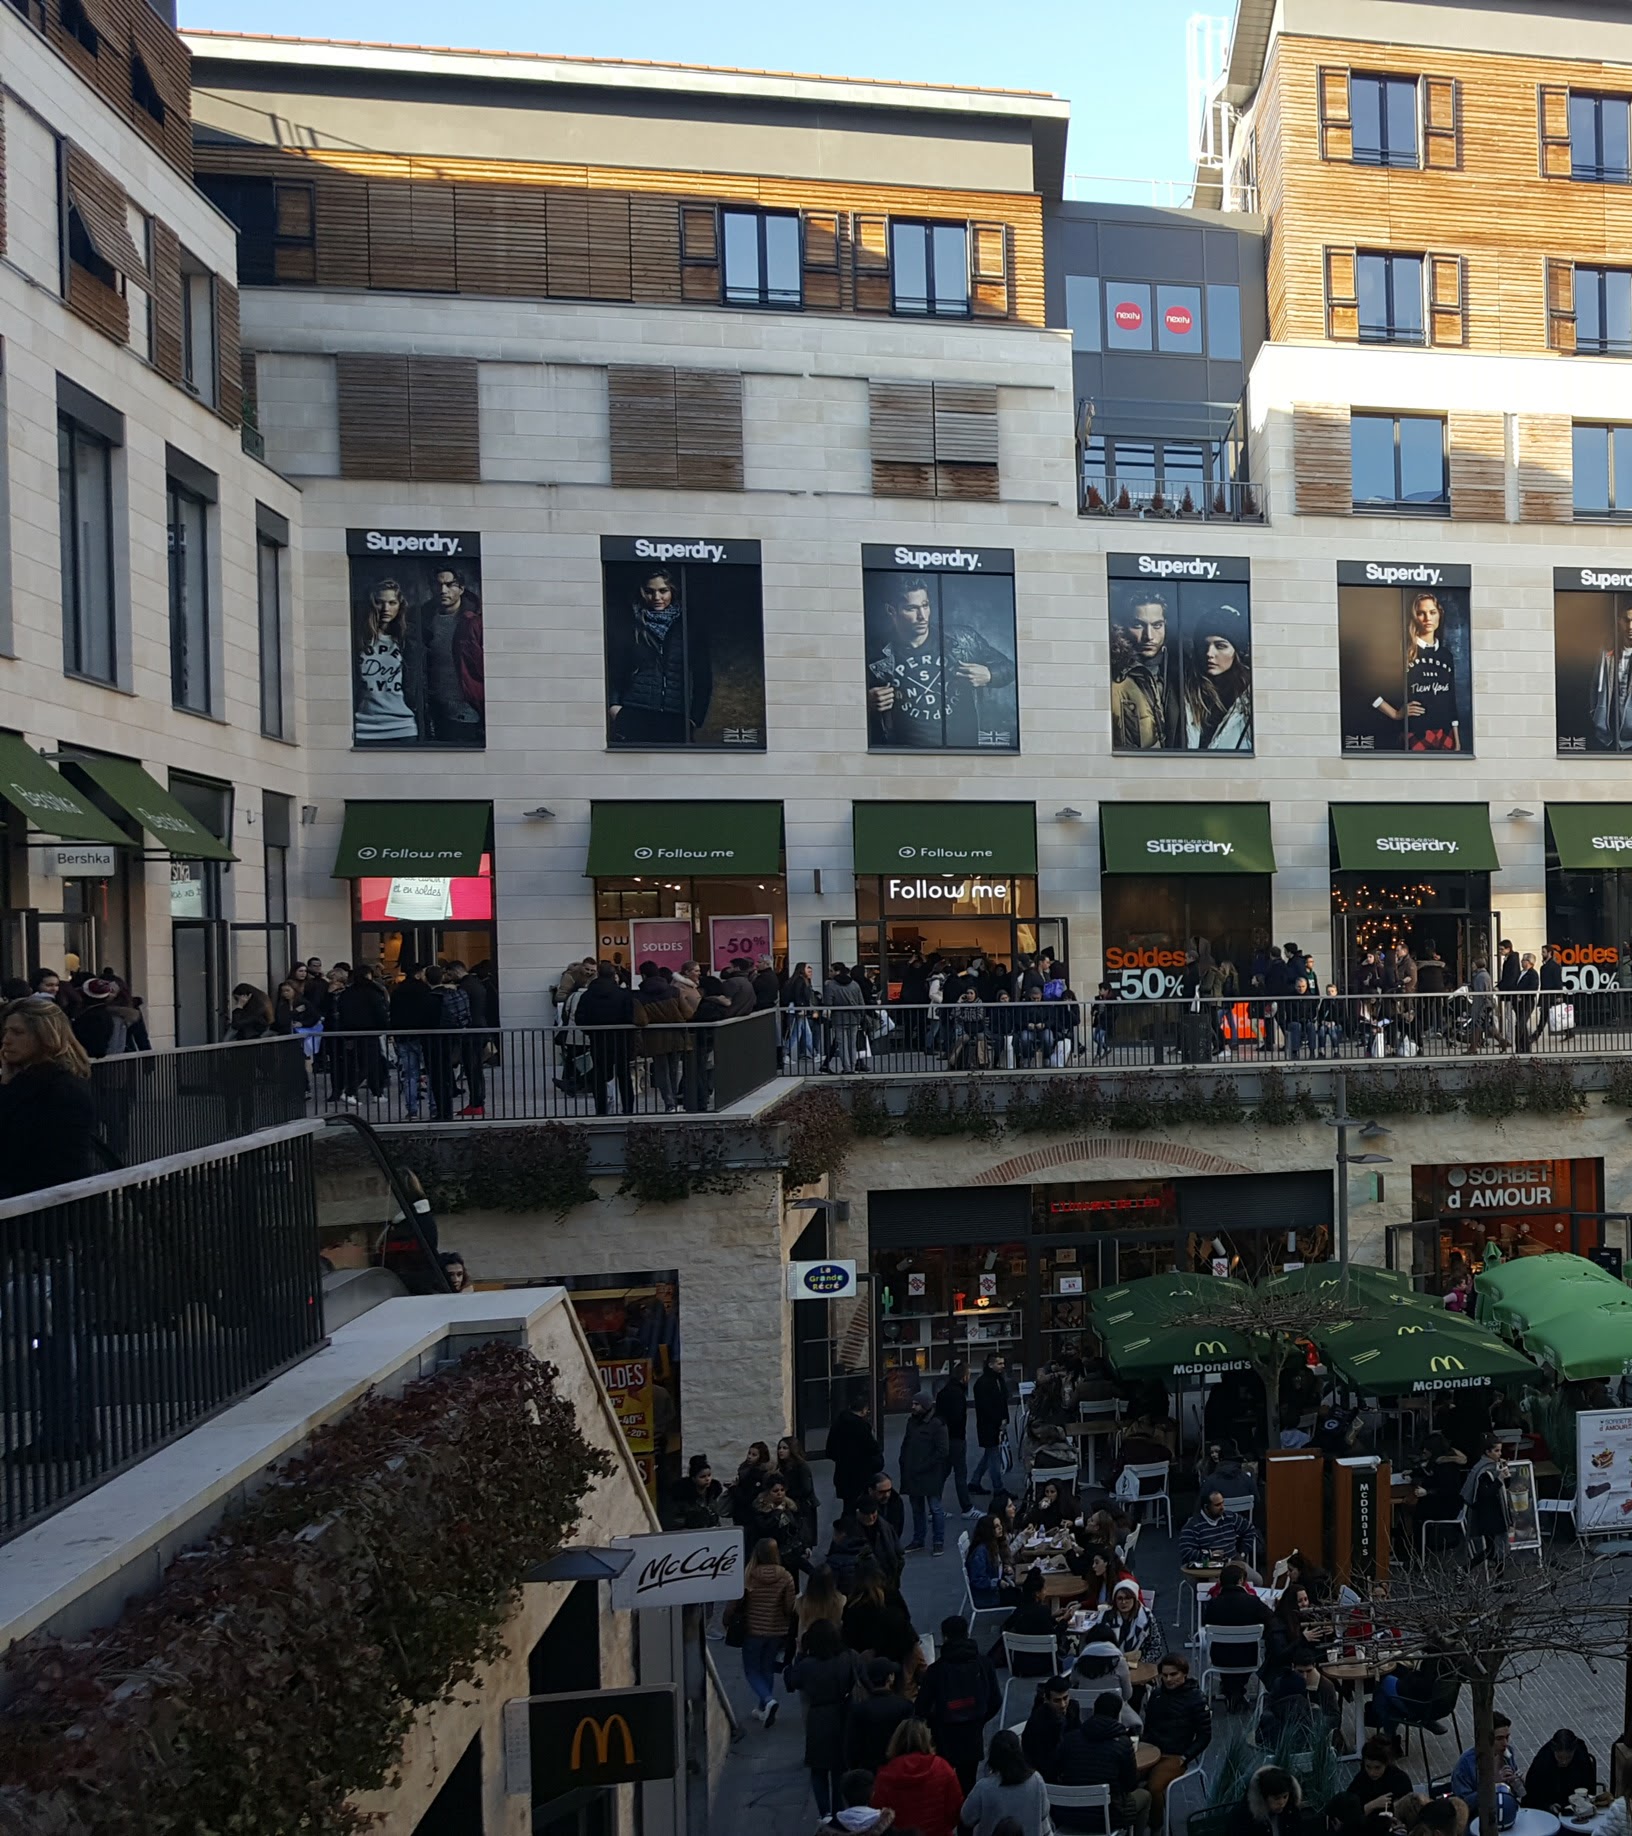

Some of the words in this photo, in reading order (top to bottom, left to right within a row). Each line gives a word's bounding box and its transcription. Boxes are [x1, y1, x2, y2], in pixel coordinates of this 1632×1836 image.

[1116, 311, 1140, 320] nexity
[1166, 315, 1190, 324] nexity
[366, 531, 463, 557] Superdry.
[635, 539, 728, 563] Superdry.
[895, 547, 982, 571] Superdry.
[1138, 556, 1221, 579] Superdry.
[1365, 563, 1443, 586] Superdry.
[10, 783, 84, 815] Bershka
[137, 807, 196, 834] Bershka
[382, 848, 435, 859] Follow
[437, 850, 463, 859] me
[657, 848, 708, 859] Follow
[711, 849, 735, 858] me
[920, 847, 968, 858] Follow
[970, 849, 993, 857] me
[1146, 839, 1234, 856] Superdry.
[1376, 837, 1460, 853] Superdry.
[57, 852, 111, 865] Bershka
[415, 886, 442, 897] soldes
[889, 879, 965, 899] Follow
[971, 883, 1007, 899] me
[642, 942, 683, 952] SOLDES
[718, 936, 766, 954] -50%
[1550, 943, 1619, 965] Soldes
[1105, 946, 1187, 969] Soldes
[1468, 1165, 1549, 1185] SORBET
[1469, 1186, 1551, 1208] AMOUR
[808, 1274, 843, 1283] Grande
[819, 1266, 832, 1275] La
[812, 1281, 840, 1291] Récré
[600, 1363, 645, 1389] OLDES
[1172, 1359, 1252, 1376] McDonald's
[1412, 1375, 1491, 1392] McDonald's
[1359, 1482, 1370, 1556] McDonald's
[638, 1545, 739, 1588] McCafé
